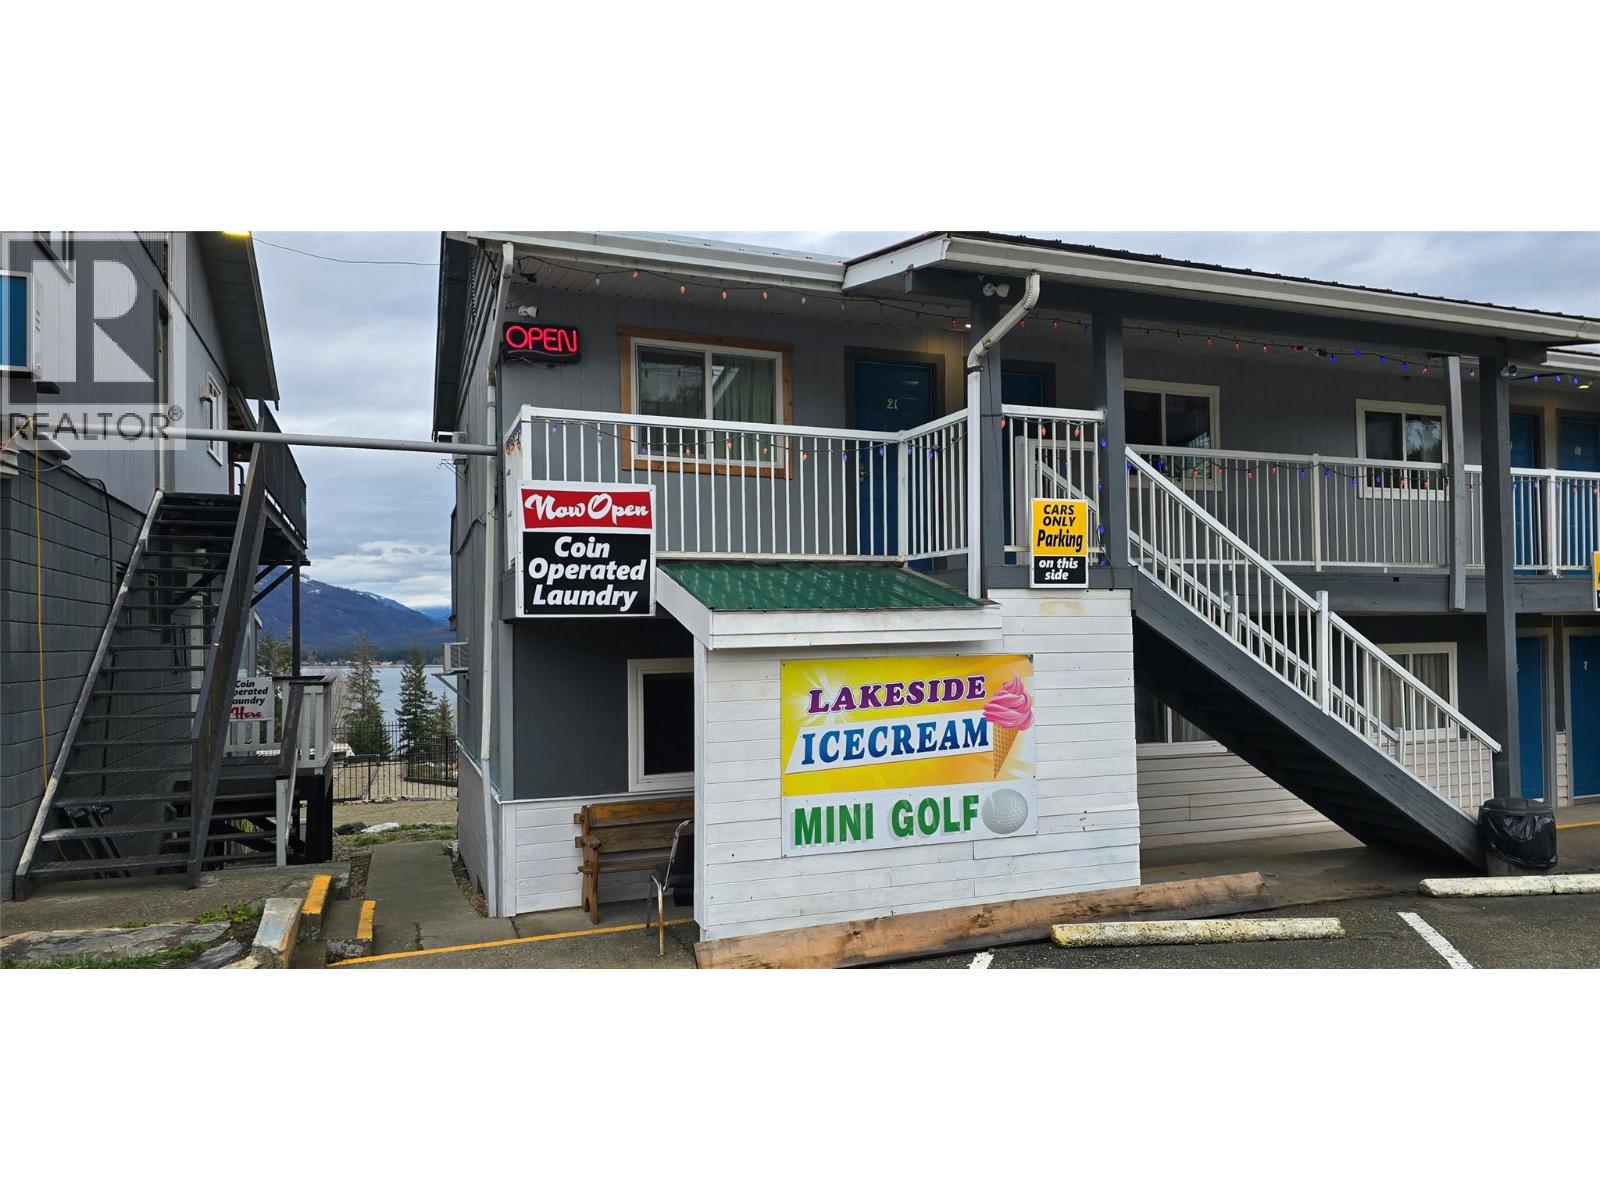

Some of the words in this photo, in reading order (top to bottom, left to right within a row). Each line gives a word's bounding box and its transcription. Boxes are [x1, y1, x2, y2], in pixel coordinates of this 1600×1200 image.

[505, 325, 578, 353] OPEN
[524, 493, 587, 521] Now
[587, 492, 649, 526] Open
[1042, 515, 1077, 527] ONLY
[1043, 504, 1075, 516] CARS
[554, 535, 611, 558] Coin
[1037, 528, 1083, 553] Parking
[528, 557, 648, 585] Operated
[1038, 559, 1054, 569] on
[1056, 557, 1079, 569] this
[1044, 568, 1070, 581] side
[532, 584, 639, 612] Laundry
[231, 696, 266, 706] aundry
[233, 687, 269, 696] perated
[807, 675, 987, 715] LAKESIDE
[230, 705, 265, 720] Here
[801, 718, 990, 765] ICECREAM
[794, 802, 874, 846] MINI
[891, 794, 980, 839] GOLF
